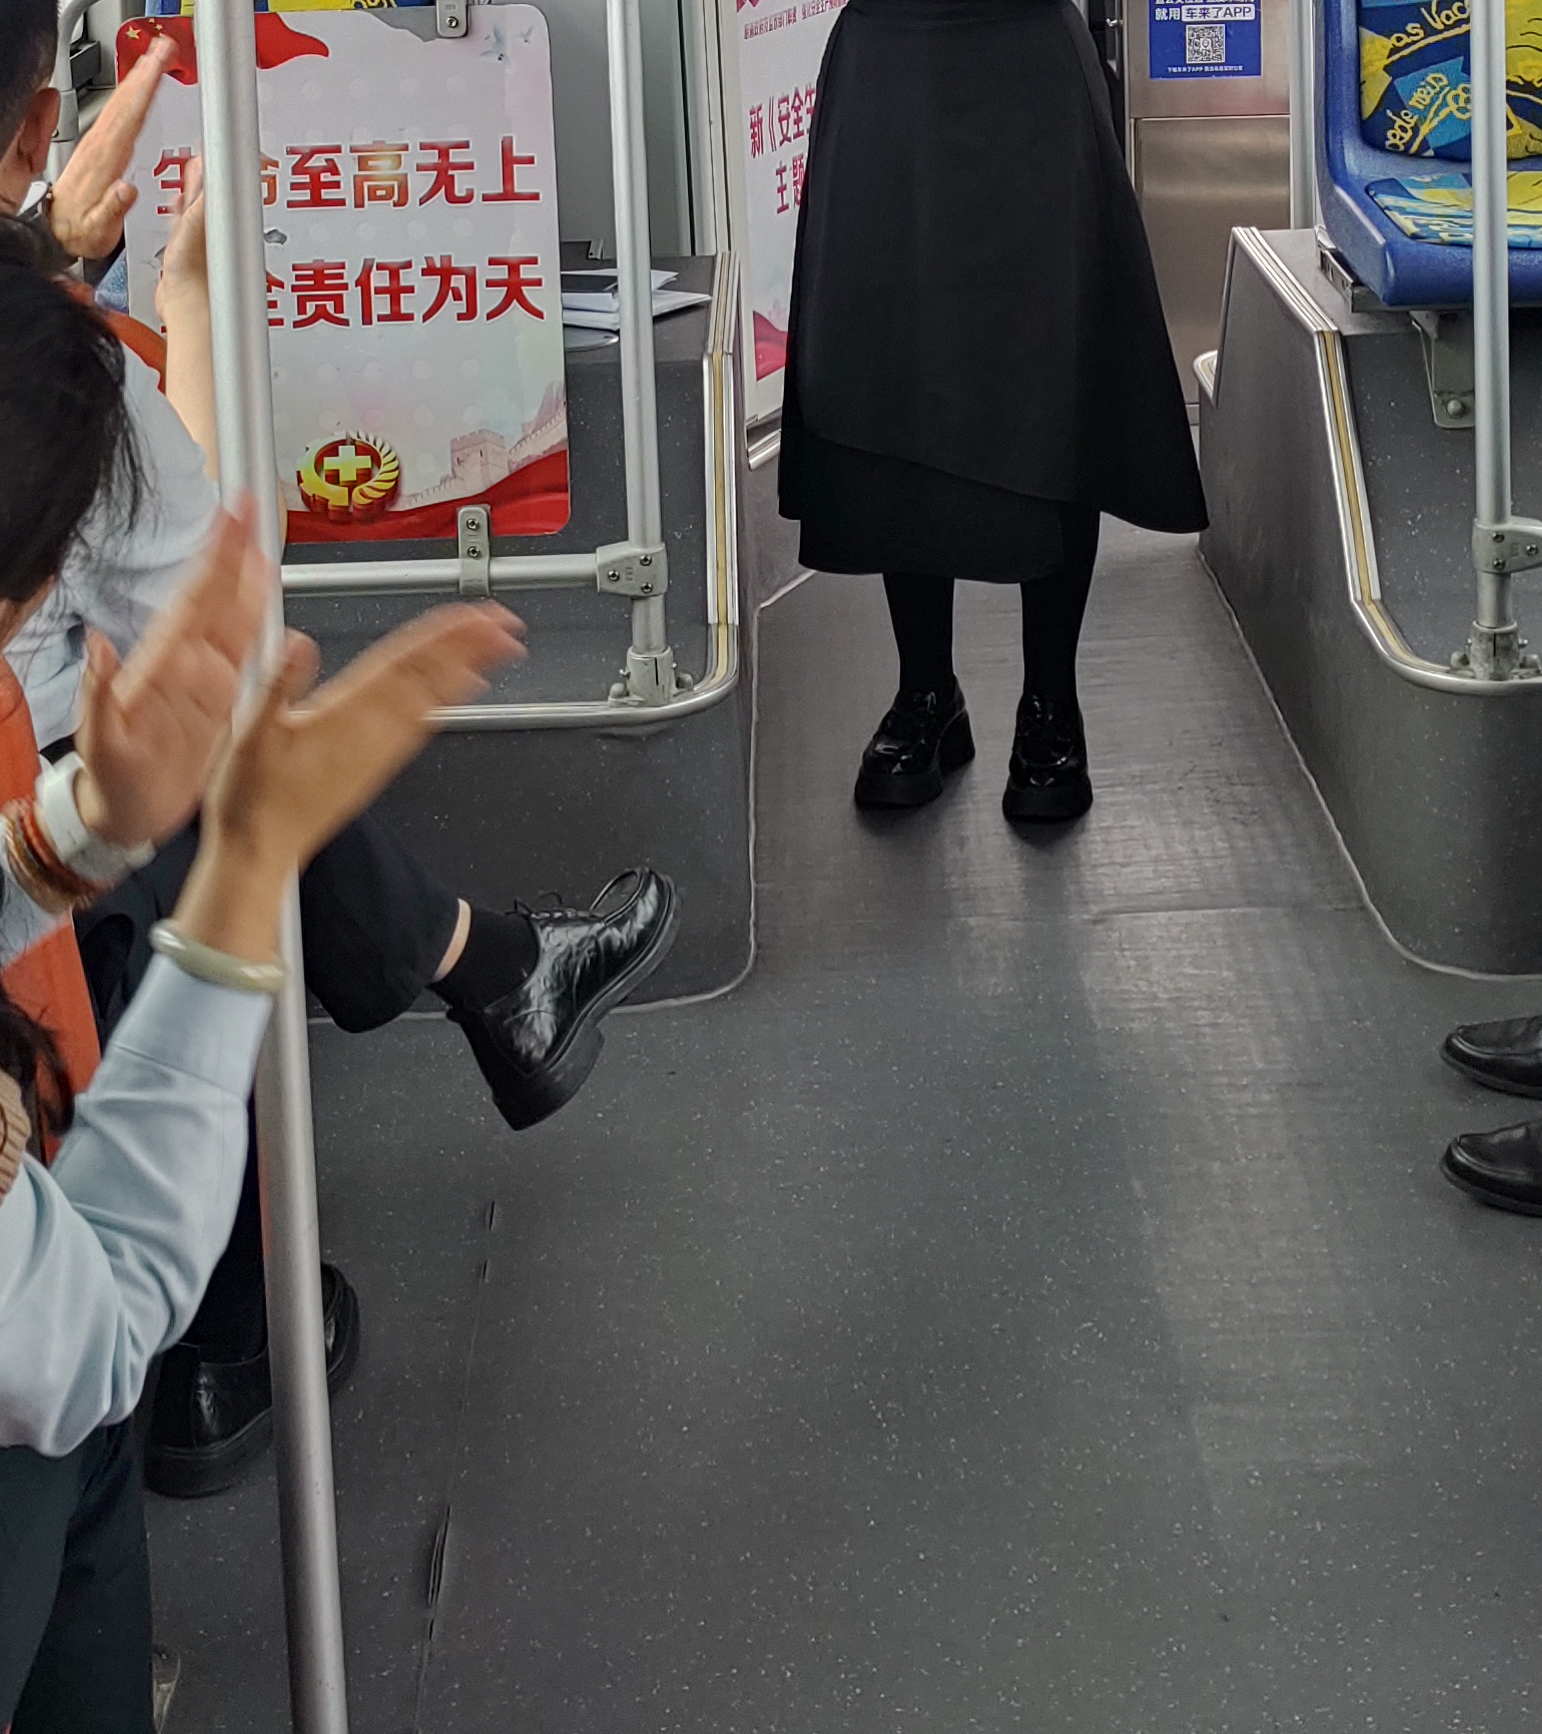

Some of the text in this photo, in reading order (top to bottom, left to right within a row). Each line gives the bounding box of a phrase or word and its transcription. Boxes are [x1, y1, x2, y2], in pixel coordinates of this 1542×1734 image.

[1155, 7, 1251, 20] 就用 车来了APP
